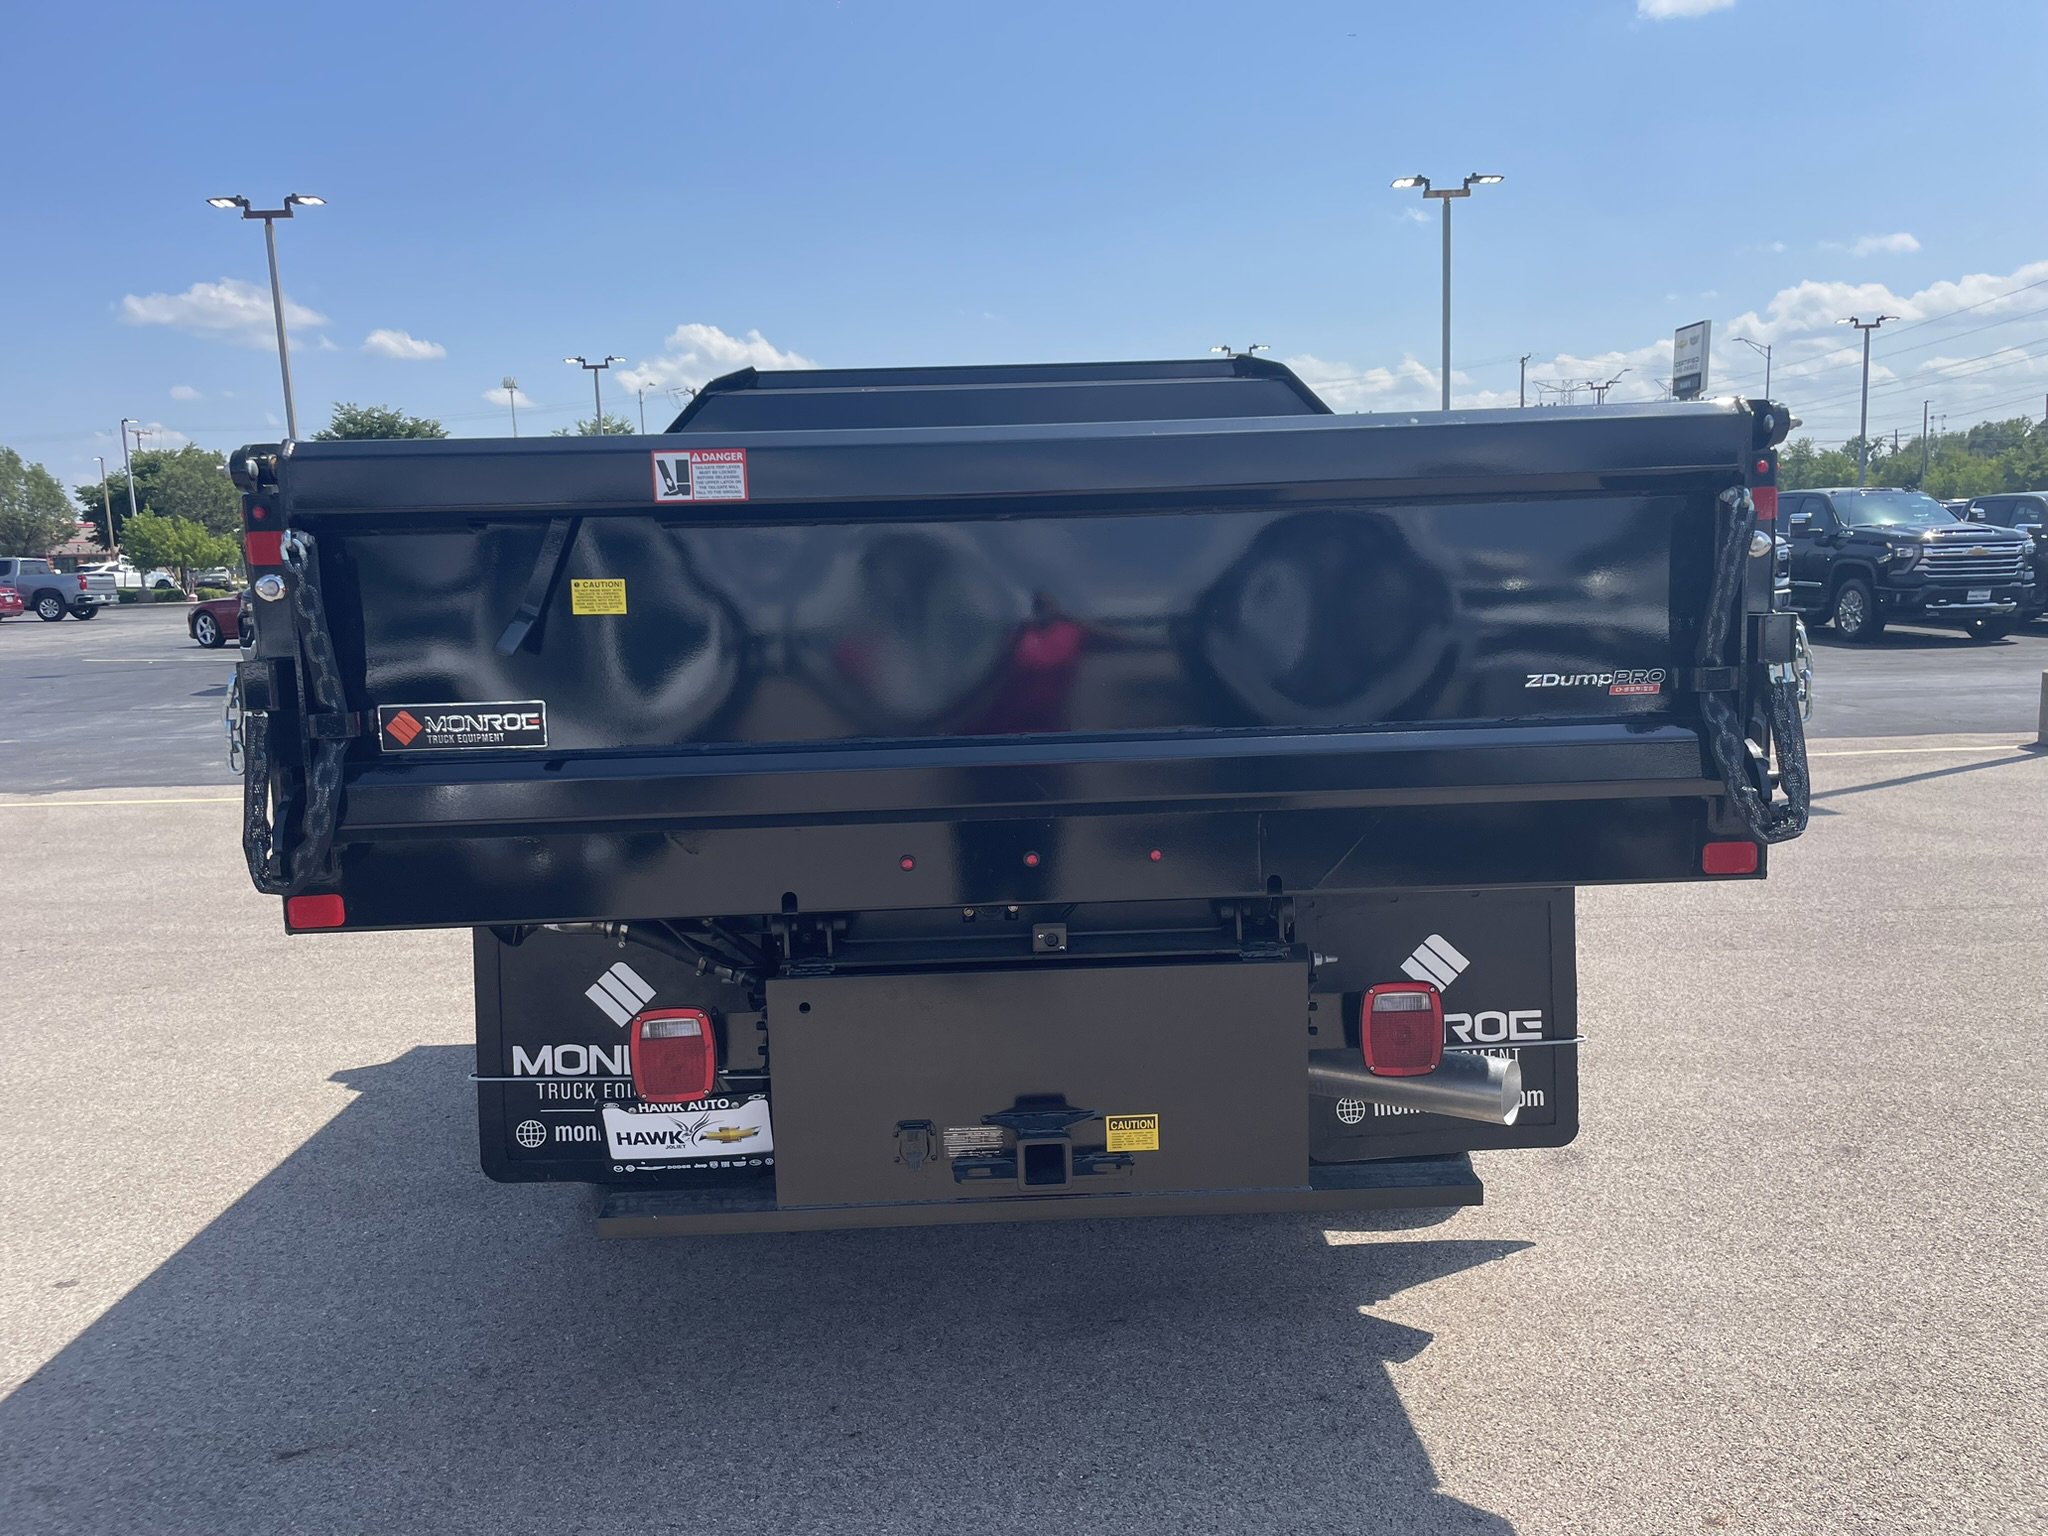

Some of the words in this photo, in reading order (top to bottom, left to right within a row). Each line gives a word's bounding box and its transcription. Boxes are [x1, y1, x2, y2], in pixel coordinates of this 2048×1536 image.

[702, 452, 743, 461] DANGER
[424, 712, 541, 734] MONROE
[426, 734, 456, 745] TRUCK
[457, 732, 505, 744] EQUIPMENT
[1444, 1009, 1543, 1043] ROE
[512, 1044, 631, 1076] MON
[536, 1082, 596, 1100] TRUCK
[637, 1102, 685, 1113] HAWK
[687, 1099, 730, 1112] AUTO
[1110, 1119, 1154, 1130] CAUTION
[616, 1130, 685, 1146] HAWK
